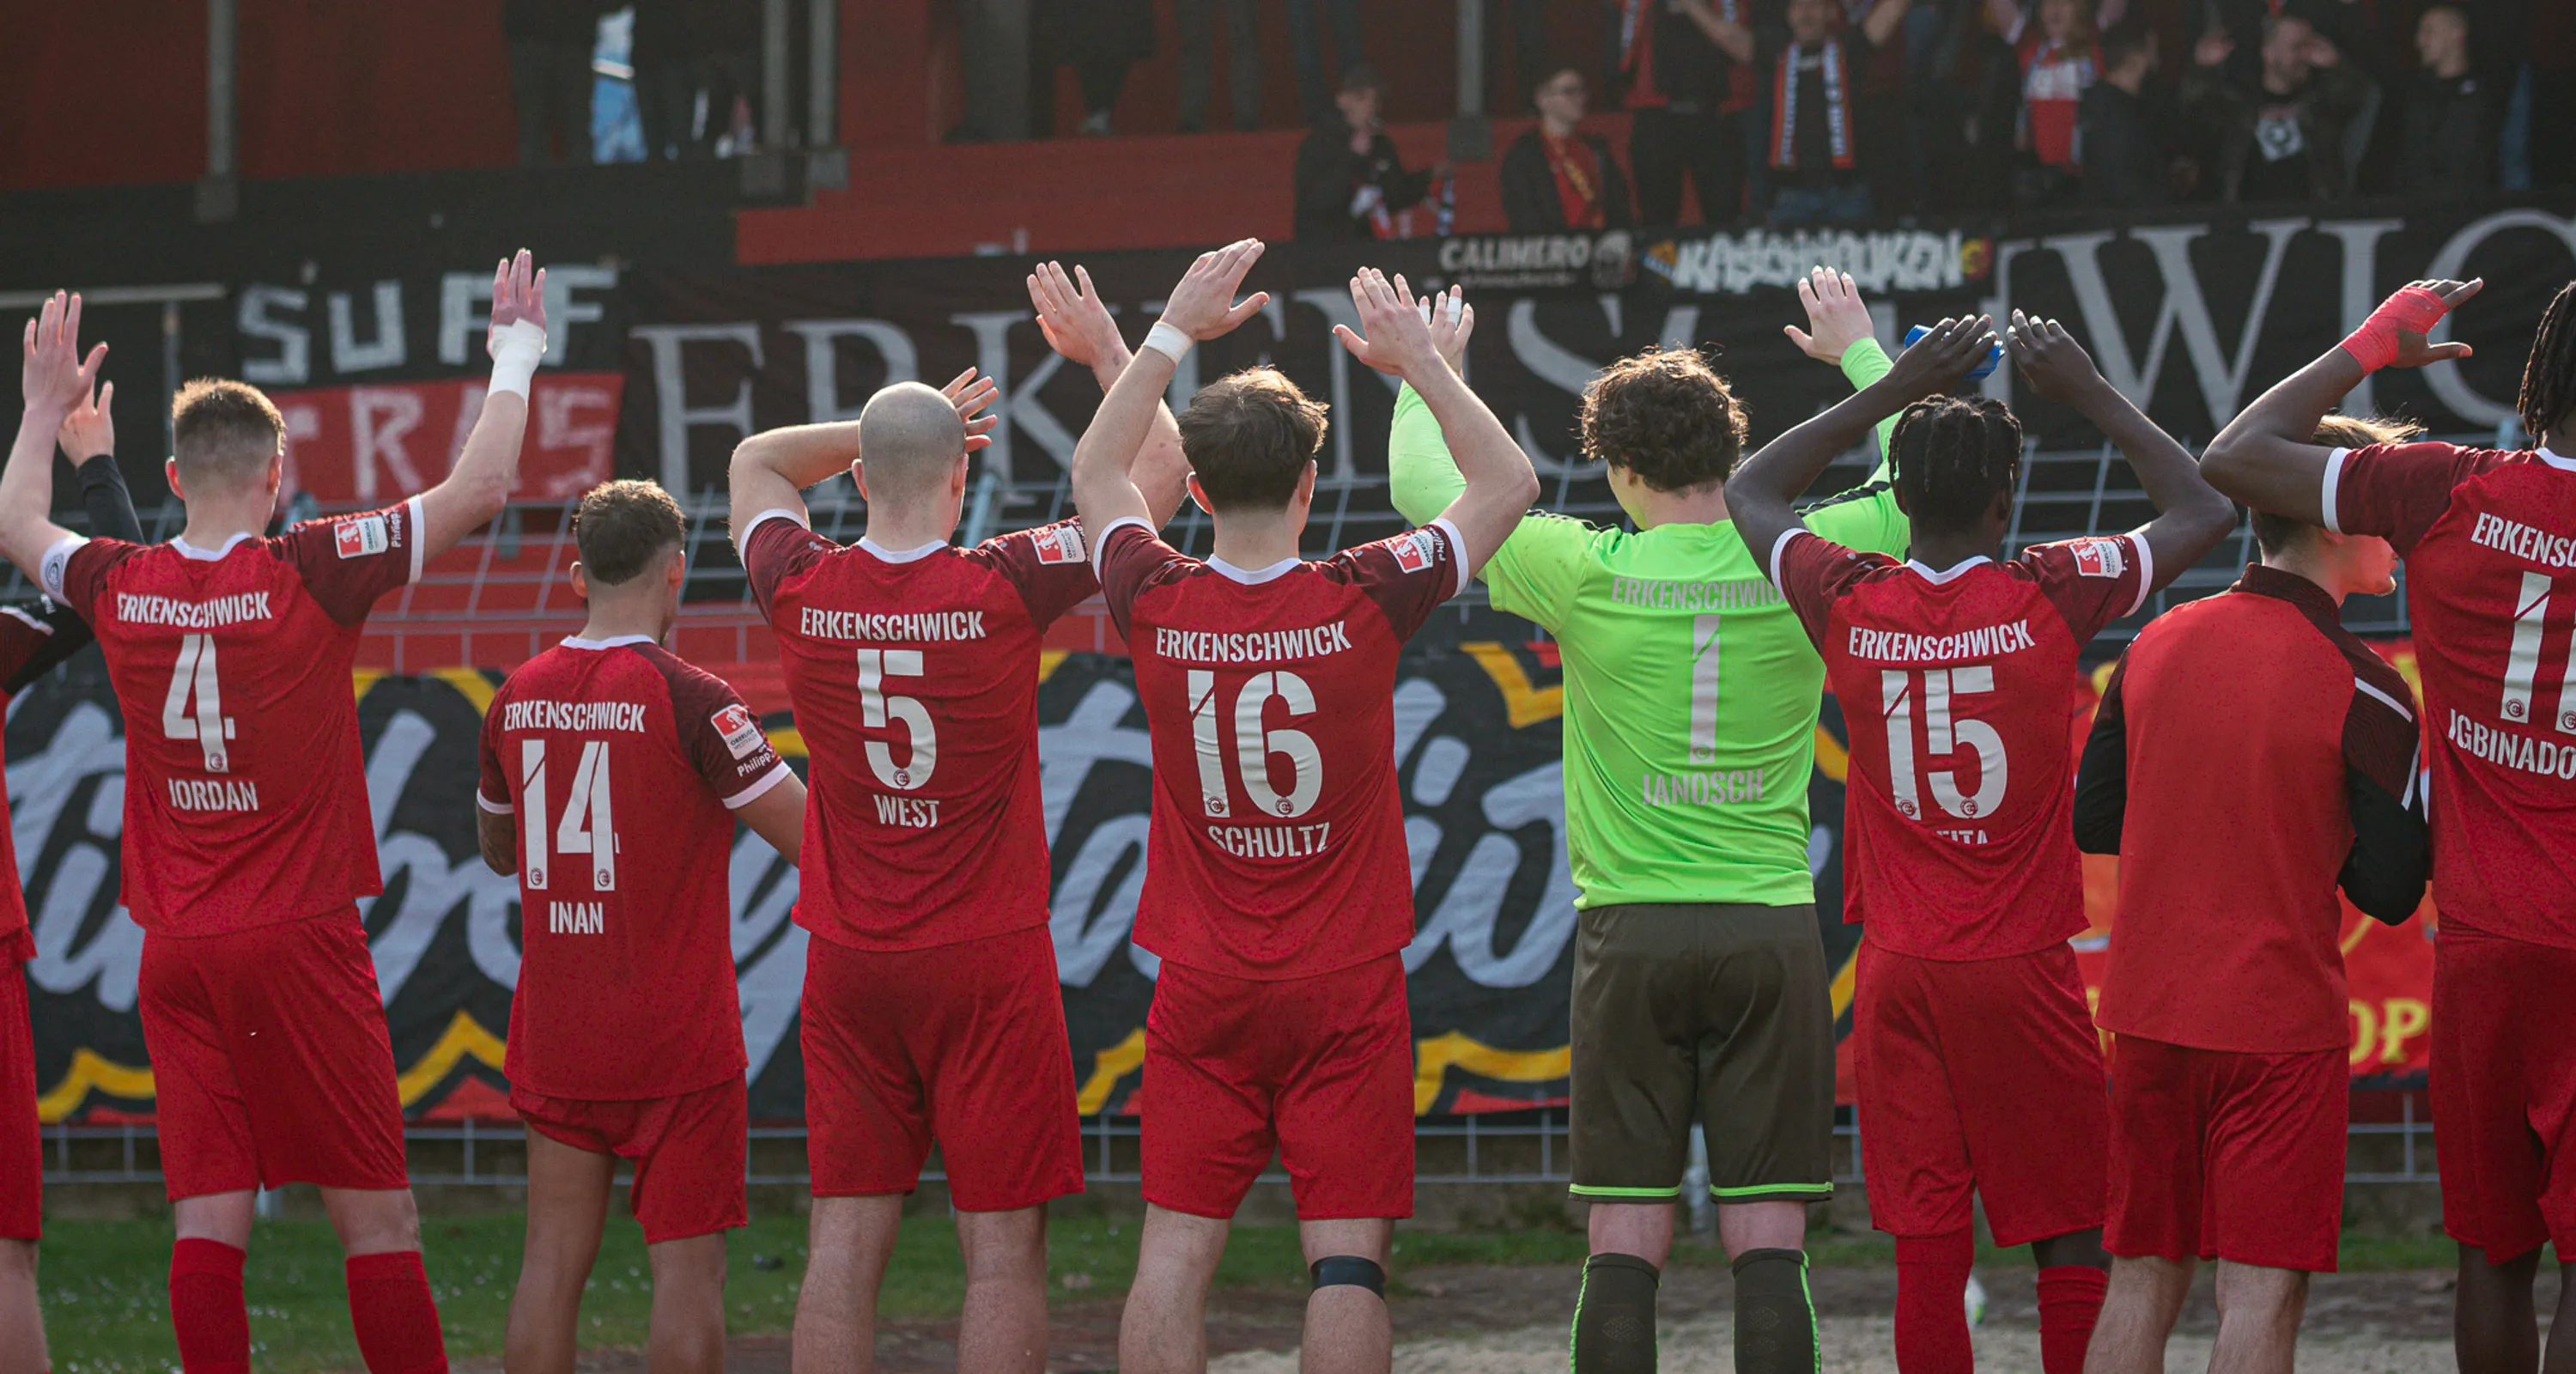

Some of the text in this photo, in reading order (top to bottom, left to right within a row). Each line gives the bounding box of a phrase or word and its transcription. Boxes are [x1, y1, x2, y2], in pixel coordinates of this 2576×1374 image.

[117, 592, 272, 628] ERKENSCHWICK
[800, 606, 987, 641] ERKENSCHWICK
[1156, 620, 1352, 662] ERKENSCHWICK
[1849, 619, 2036, 662] ERKENSCHWICK
[162, 633, 236, 773] 4
[1690, 614, 1721, 764] 1
[504, 700, 647, 733] ERKENSCHWICK
[857, 648, 937, 791] 5
[1188, 670, 1323, 818] 16
[1881, 666, 2008, 822] 15
[1643, 769, 1764, 806] JANOSCH
[522, 739, 621, 891] 14
[872, 794, 940, 829] WEST
[1207, 822, 1330, 859] SCHULTZ
[550, 901, 605, 934] INAN
